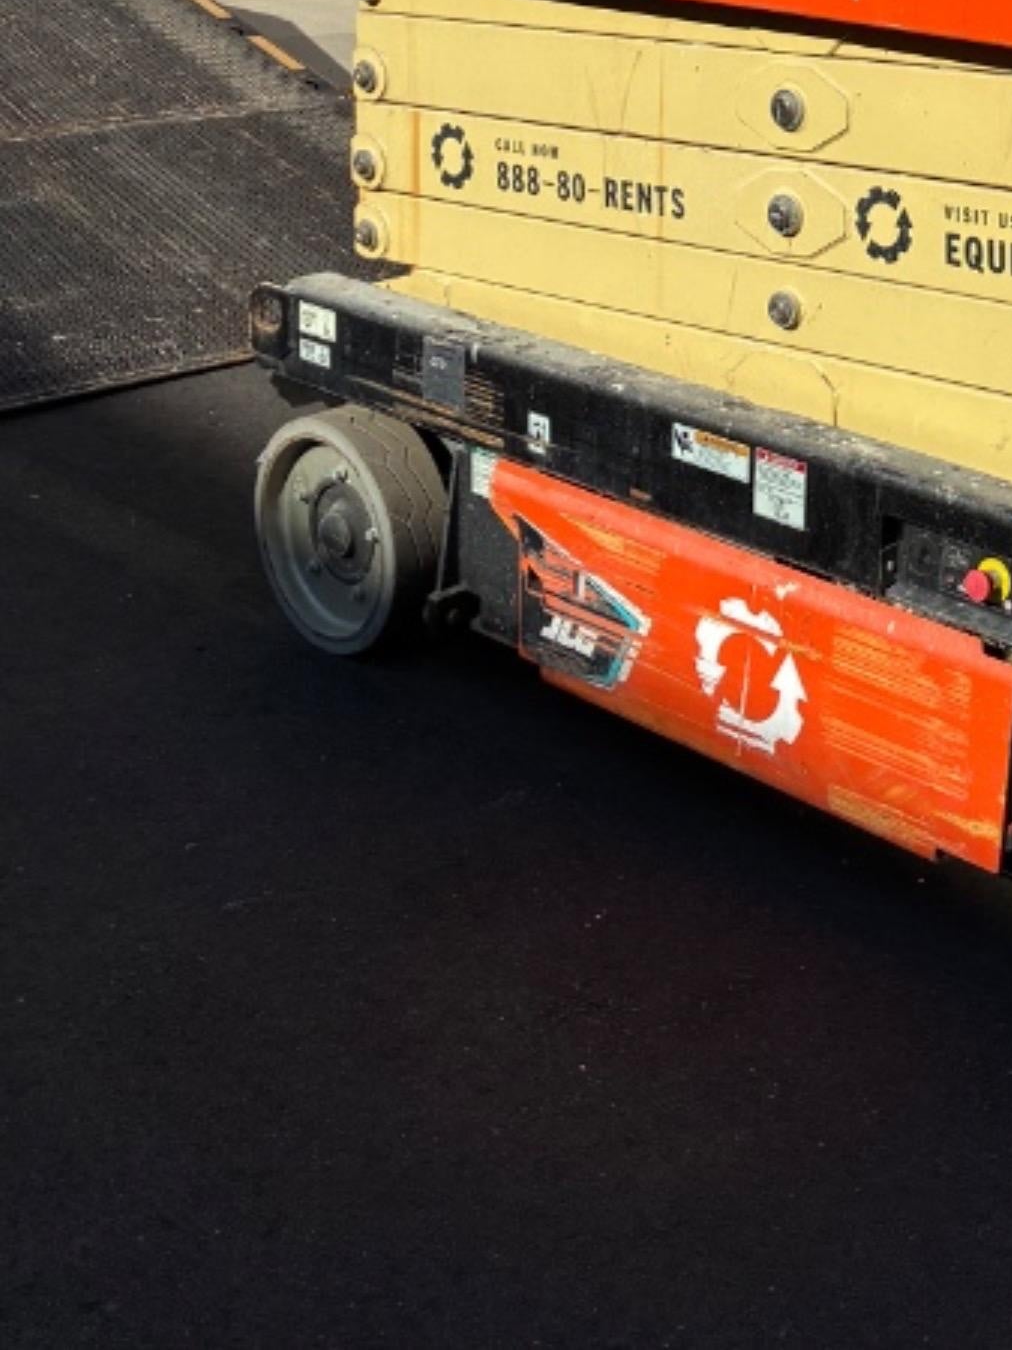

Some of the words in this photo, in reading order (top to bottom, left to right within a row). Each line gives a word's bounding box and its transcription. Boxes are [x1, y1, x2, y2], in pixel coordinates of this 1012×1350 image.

[494, 137, 526, 157] CALL
[531, 143, 559, 160] NOW
[497, 160, 685, 220] 888-80-RENTS
[943, 204, 989, 226] VISIT
